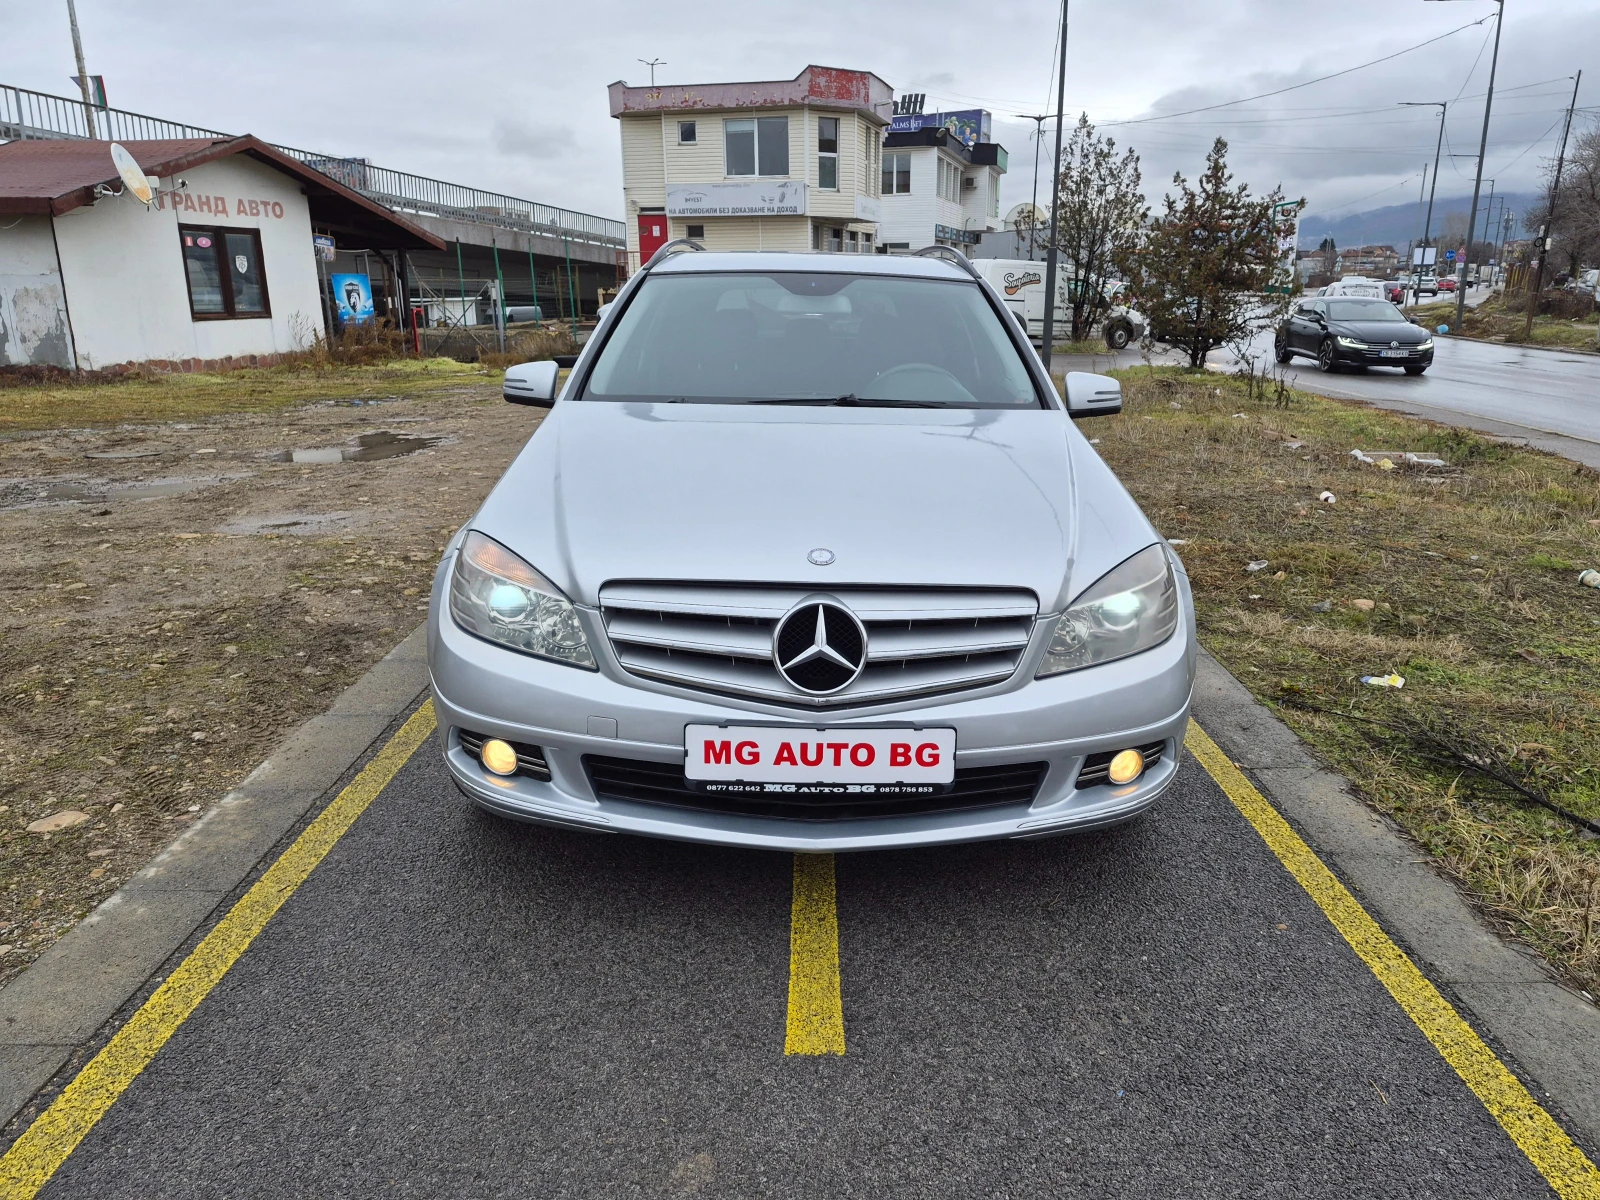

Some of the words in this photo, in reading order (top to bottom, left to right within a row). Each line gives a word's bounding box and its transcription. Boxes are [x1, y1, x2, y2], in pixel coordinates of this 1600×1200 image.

[157, 190, 229, 218] ГРАНД
[237, 198, 284, 219] АВТО
[678, 207, 718, 215] АВТОМОБИЛИ
[731, 206, 765, 215] ДОКАЗВАНЕ
[776, 206, 798, 214] ДОХОД
[703, 739, 760, 765] MG
[773, 741, 876, 767] AUTO
[889, 743, 940, 767] BG
[763, 784, 798, 792] MG
[845, 785, 877, 793] BG
